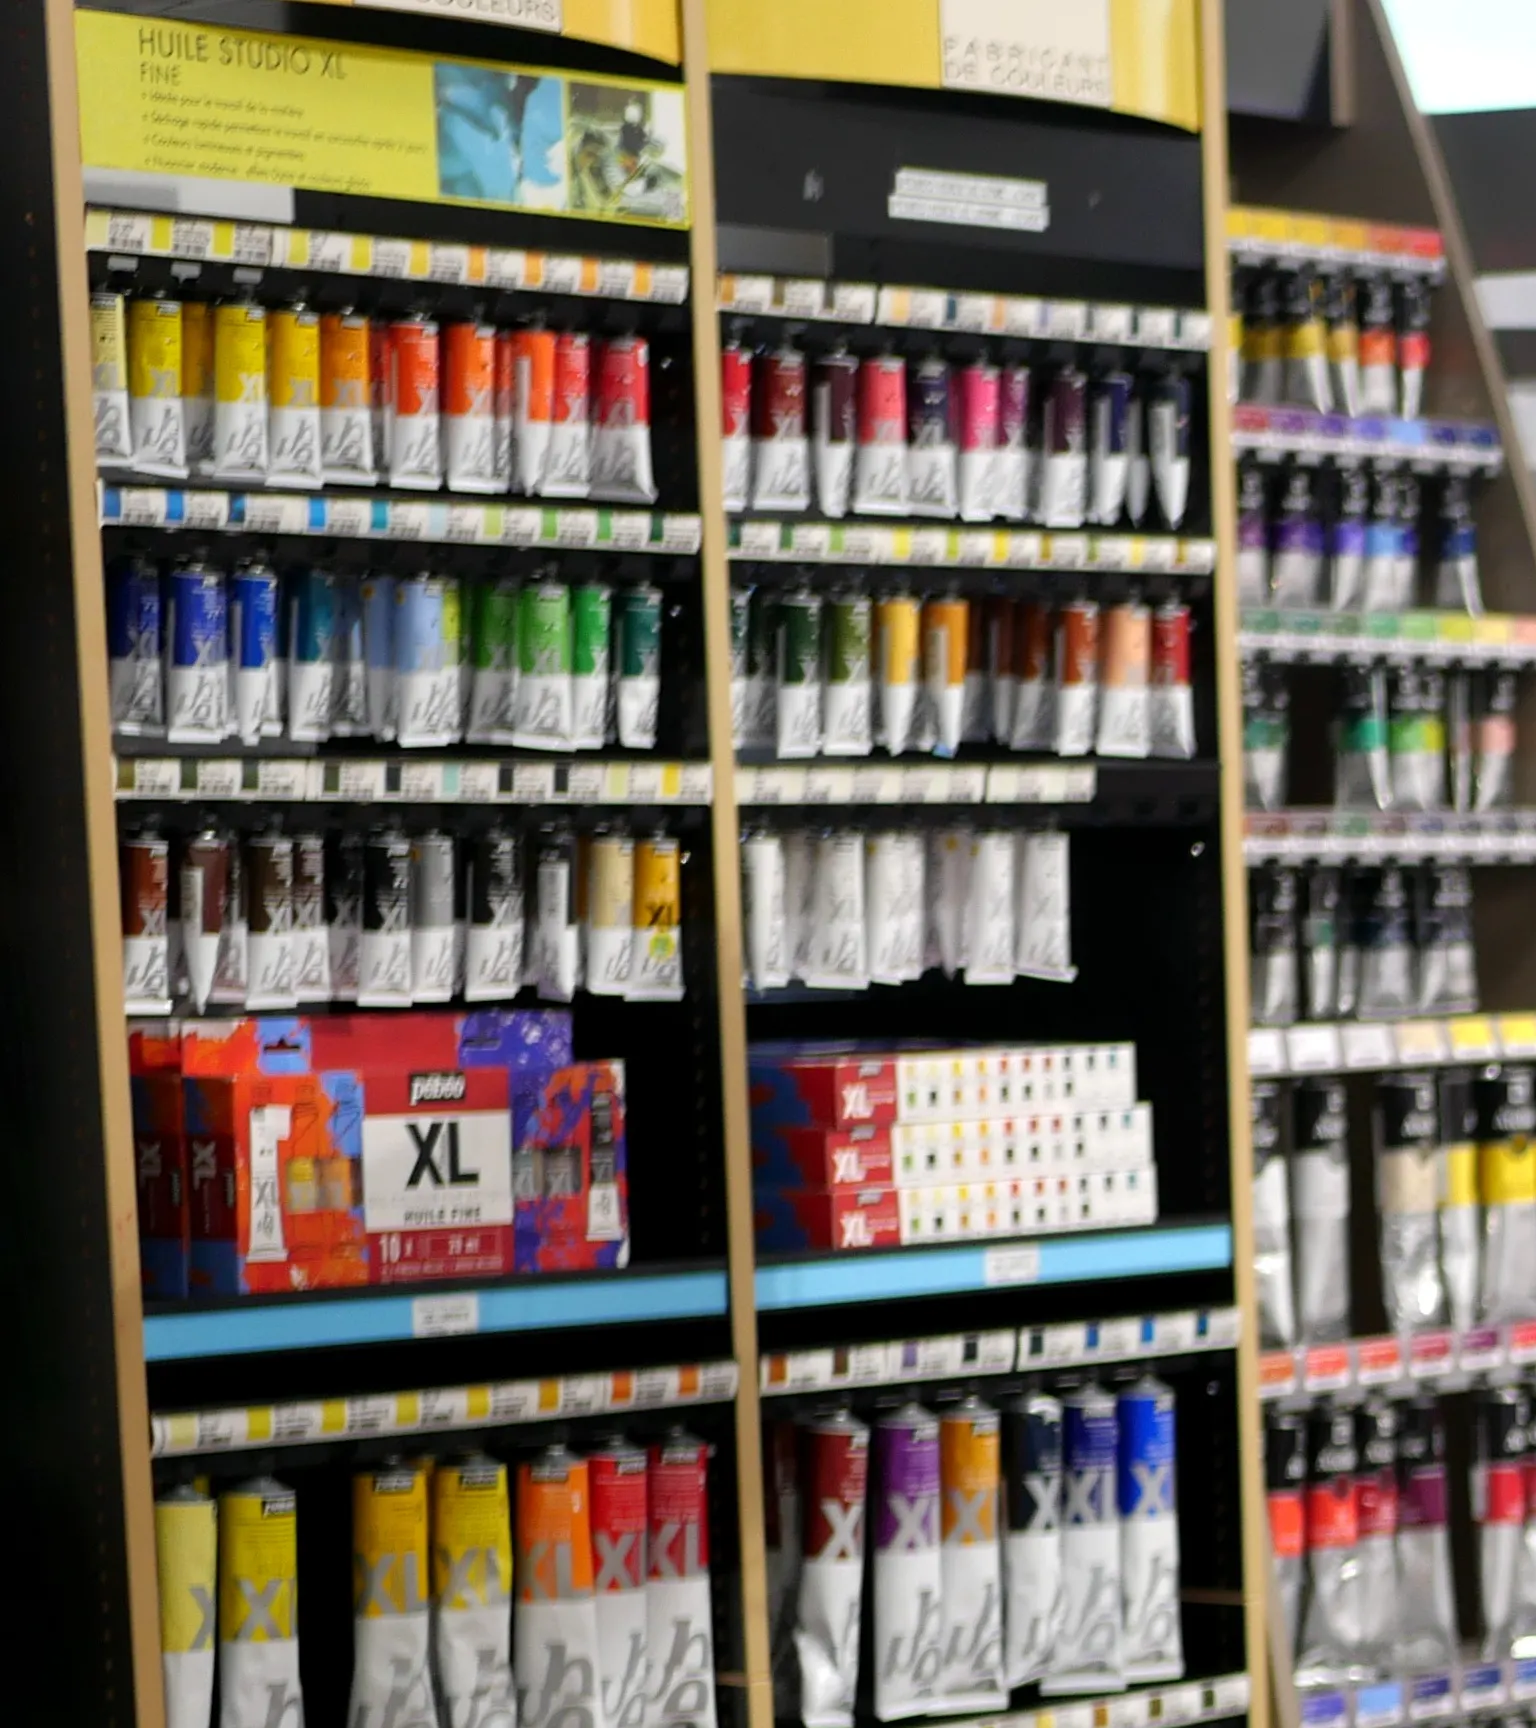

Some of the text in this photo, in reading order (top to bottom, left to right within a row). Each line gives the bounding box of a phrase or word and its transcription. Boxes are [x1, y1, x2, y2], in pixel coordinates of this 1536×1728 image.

[138, 28, 348, 79] HUILE STUDIO XL
[140, 64, 181, 87] FINE
[405, 1121, 480, 1190] XL
[379, 1234, 400, 1262] 10
[360, 1552, 427, 1617] XL
